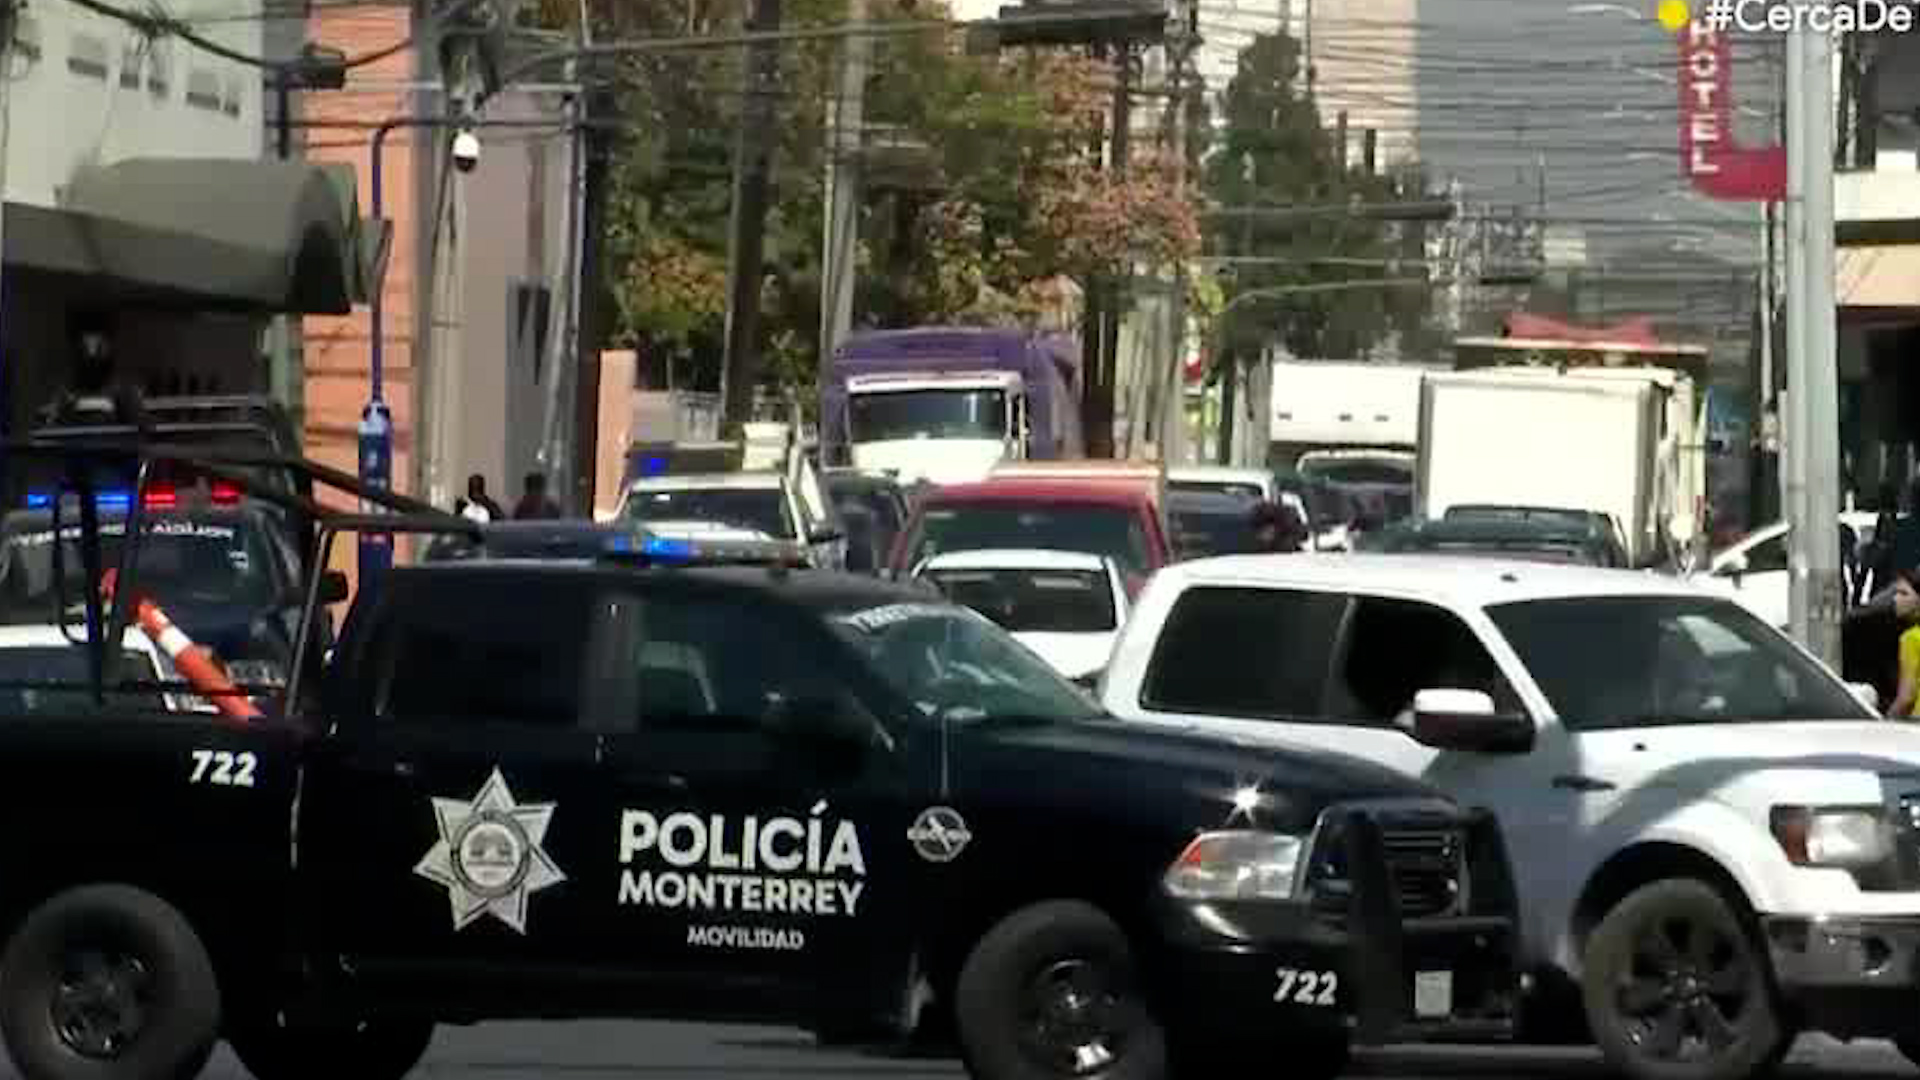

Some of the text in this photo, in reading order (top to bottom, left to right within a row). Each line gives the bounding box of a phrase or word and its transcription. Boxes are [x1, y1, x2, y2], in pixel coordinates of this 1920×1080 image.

[1689, 19, 1720, 174] HOTEL
[190, 751, 257, 786] 722
[618, 799, 867, 875] POLICÍA
[618, 869, 866, 917] MONTERREY
[687, 925, 805, 949] MOVILIDAD
[1273, 967, 1338, 1006] 722
